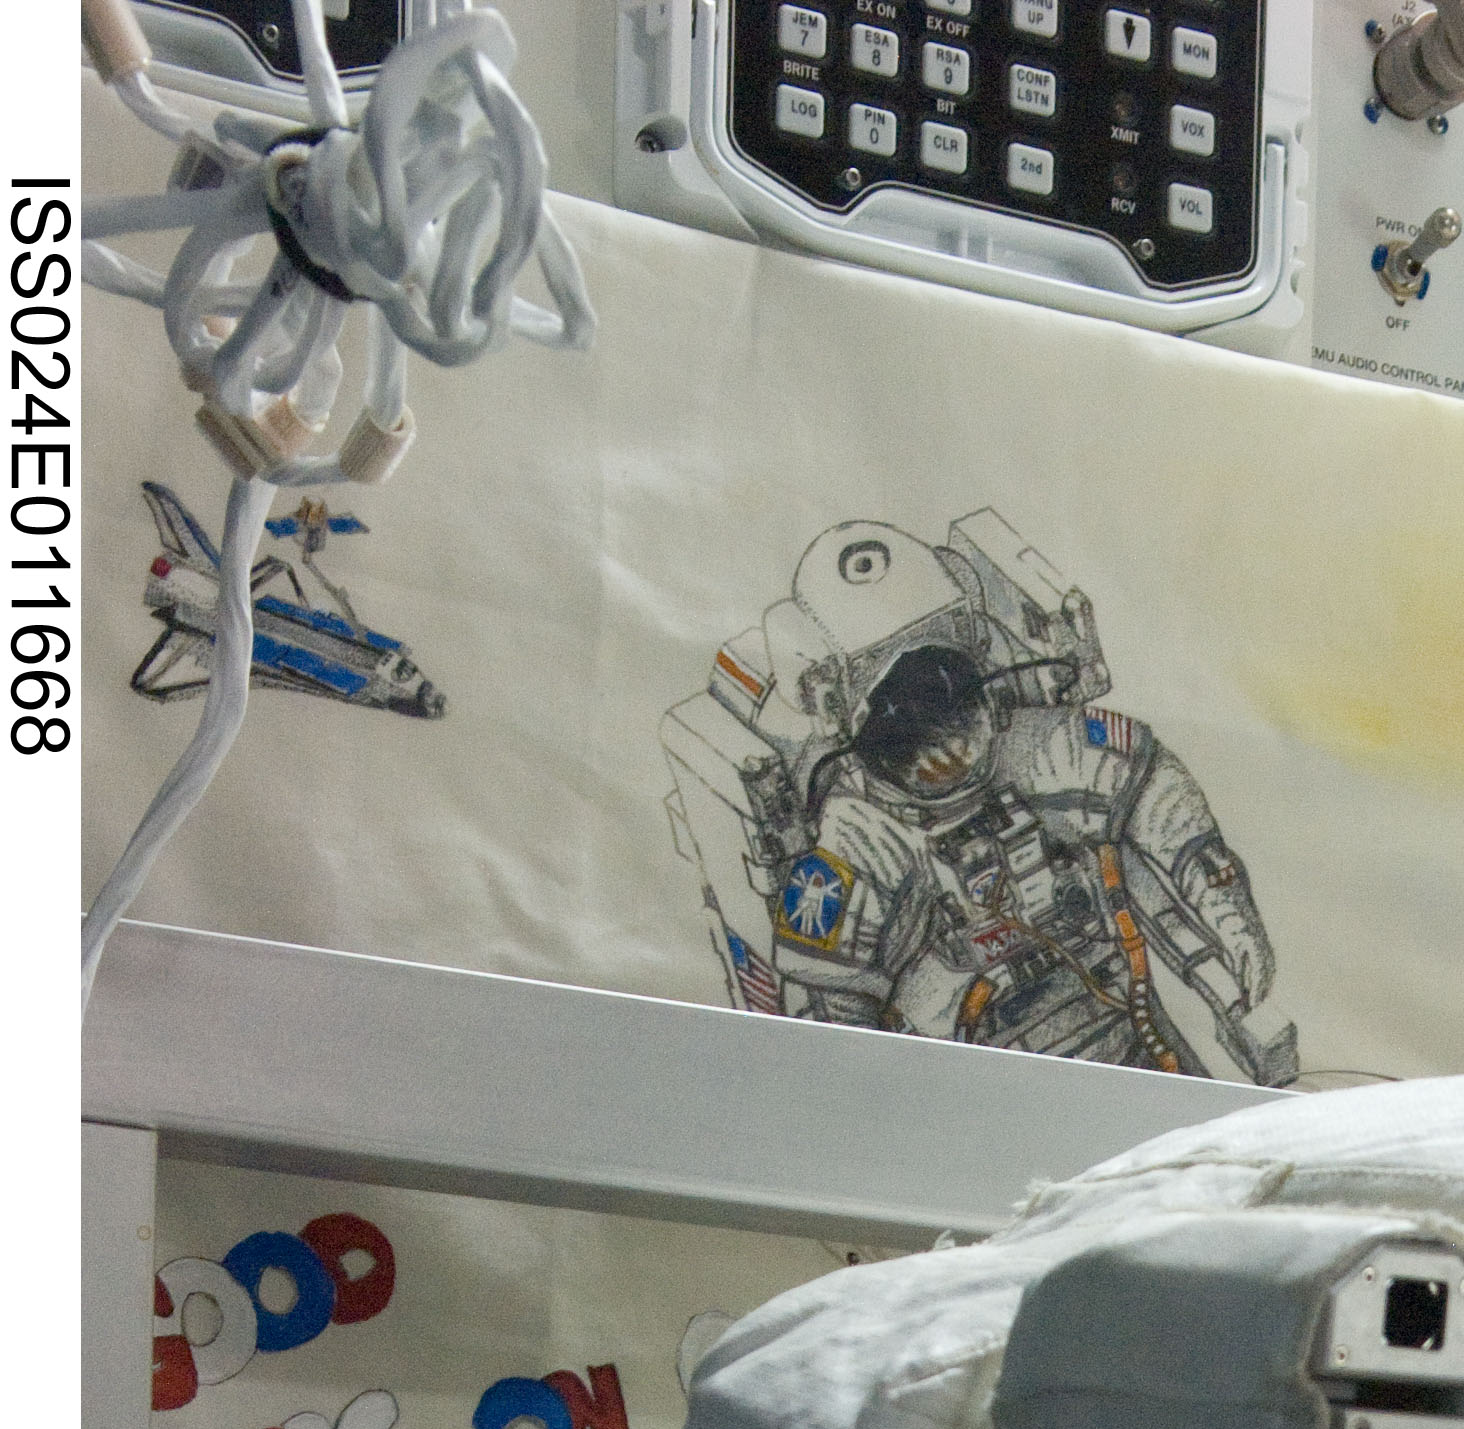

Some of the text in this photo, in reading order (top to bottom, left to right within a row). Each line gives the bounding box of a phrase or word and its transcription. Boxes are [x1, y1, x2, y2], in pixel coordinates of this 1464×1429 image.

[792, 12, 818, 28] JEM
[877, 3, 896, 19] ON
[1027, 10, 1044, 25] UP
[926, 16, 970, 38] EX OFF
[801, 30, 809, 47] 7
[865, 30, 890, 47] ESA
[871, 49, 881, 66] 8
[936, 49, 961, 66] RSA
[1183, 42, 1210, 61] MON
[783, 60, 820, 81] BRITE
[943, 67, 953, 85] 9
[1017, 69, 1050, 87] CONF
[1017, 88, 1049, 107] LSTN
[791, 99, 817, 118] LOG
[937, 99, 956, 115] BIT
[864, 109, 886, 125] PIN
[1110, 126, 1140, 145] XMIT
[1182, 120, 1205, 138] VOX
[933, 135, 958, 153] CLR
[1021, 157, 1043, 175] 2nd
[1111, 197, 1136, 214] RCV
[1179, 197, 1202, 216] VOL
[1376, 216, 1404, 235] PWR
[1385, 316, 1411, 332] OFF
[1338, 352, 1378, 373] AUDIO
[1381, 361, 1441, 387] CONTROL
